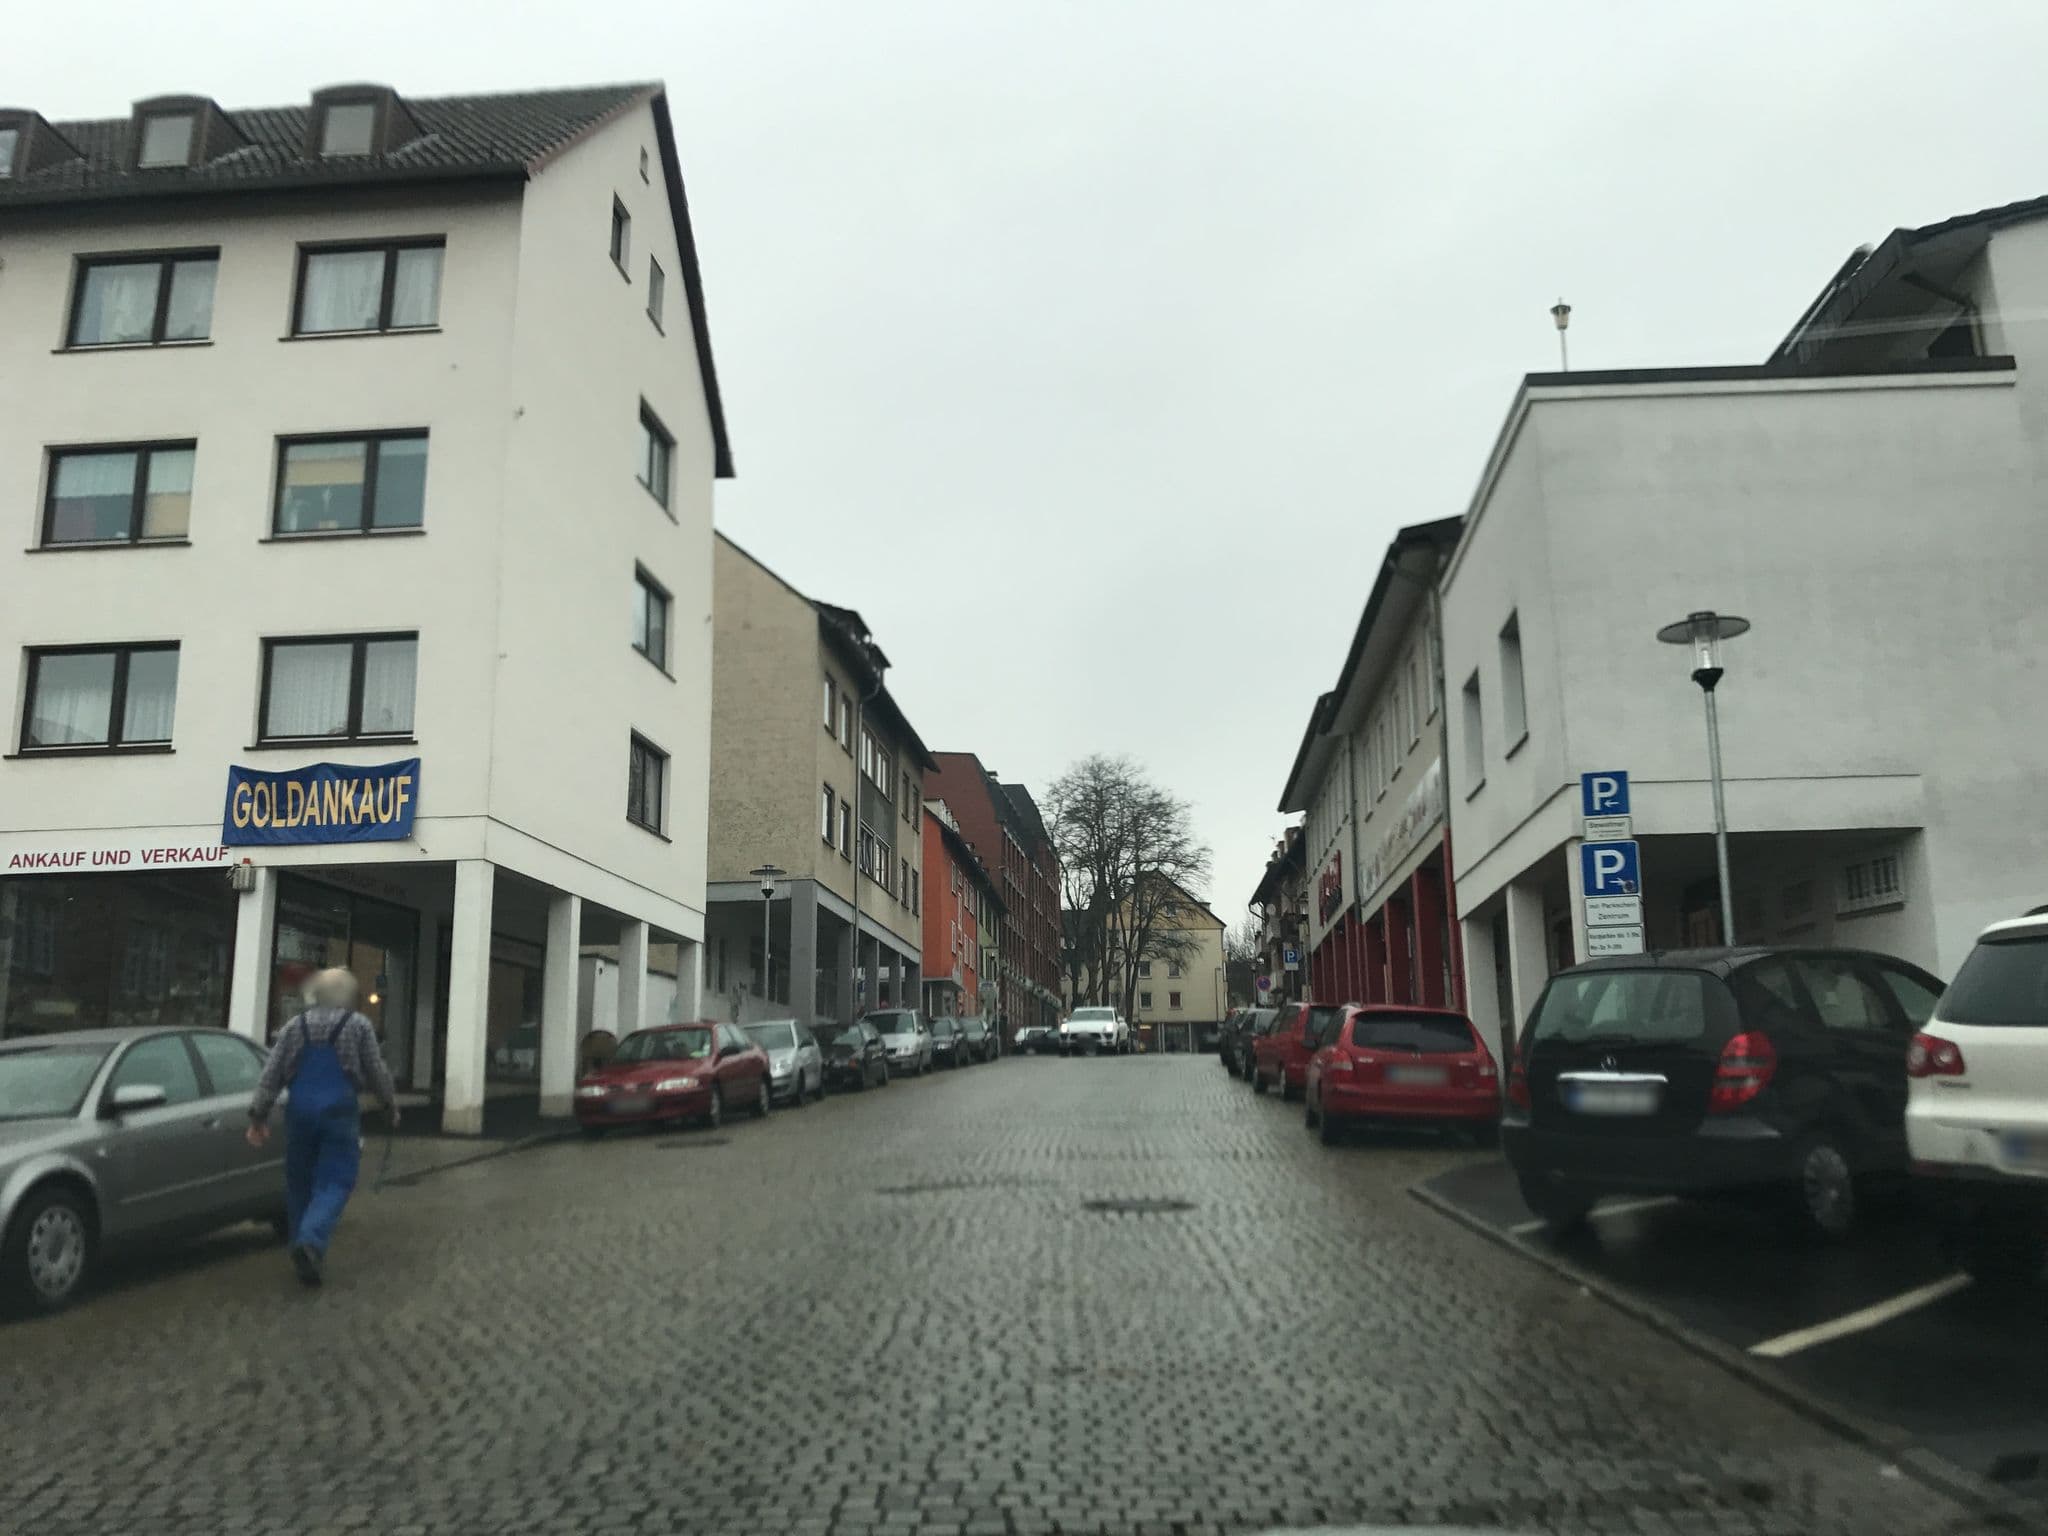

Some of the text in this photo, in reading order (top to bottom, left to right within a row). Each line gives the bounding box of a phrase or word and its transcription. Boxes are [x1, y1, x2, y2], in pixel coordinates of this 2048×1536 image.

[232, 776, 412, 828] GOLDANKAUF
[1592, 777, 1618, 811] P
[8, 846, 230, 869] ANKAUF UND VERKAUF
[1594, 850, 1625, 890] P
[1287, 951, 1295, 962] P
